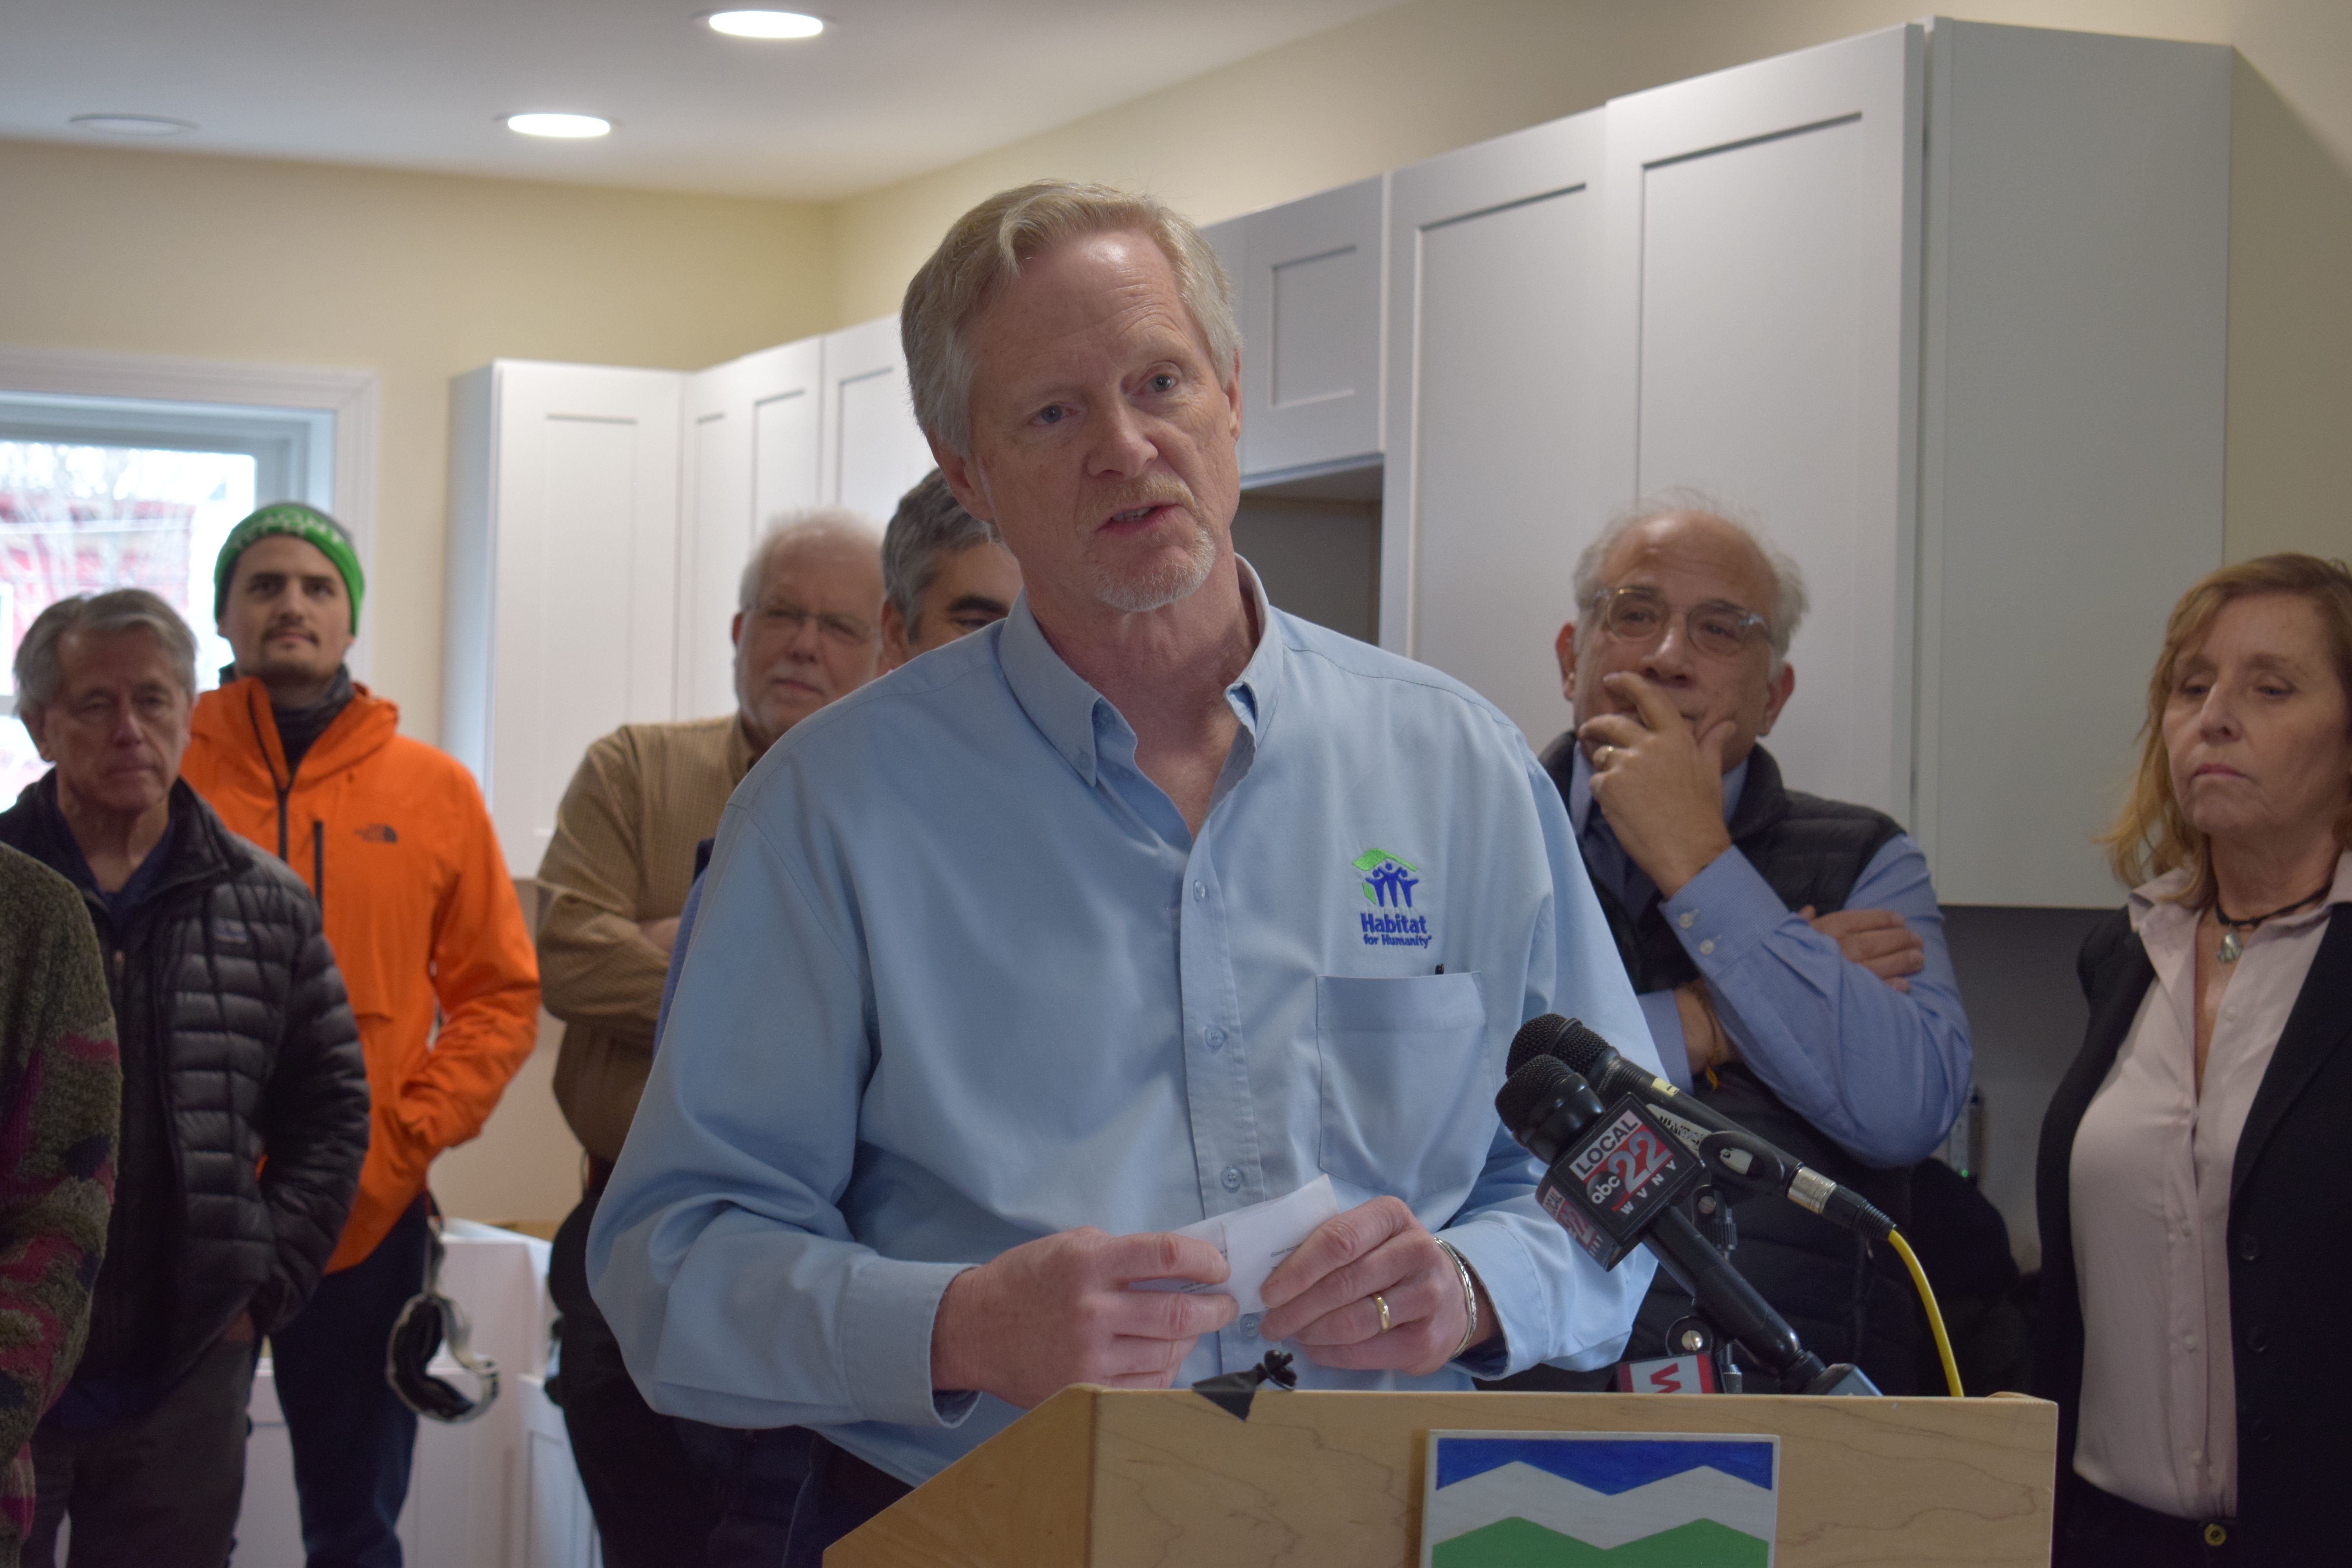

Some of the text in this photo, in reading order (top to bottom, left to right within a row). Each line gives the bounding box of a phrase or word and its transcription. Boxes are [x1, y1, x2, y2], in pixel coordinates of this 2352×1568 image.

[1360, 913, 1427, 934] Habitat
[1363, 933, 1432, 949] for Humanity
[1575, 1120, 1638, 1175] LOCAL
[1592, 1176, 1621, 1204] abc
[1608, 1131, 1673, 1194] 22
